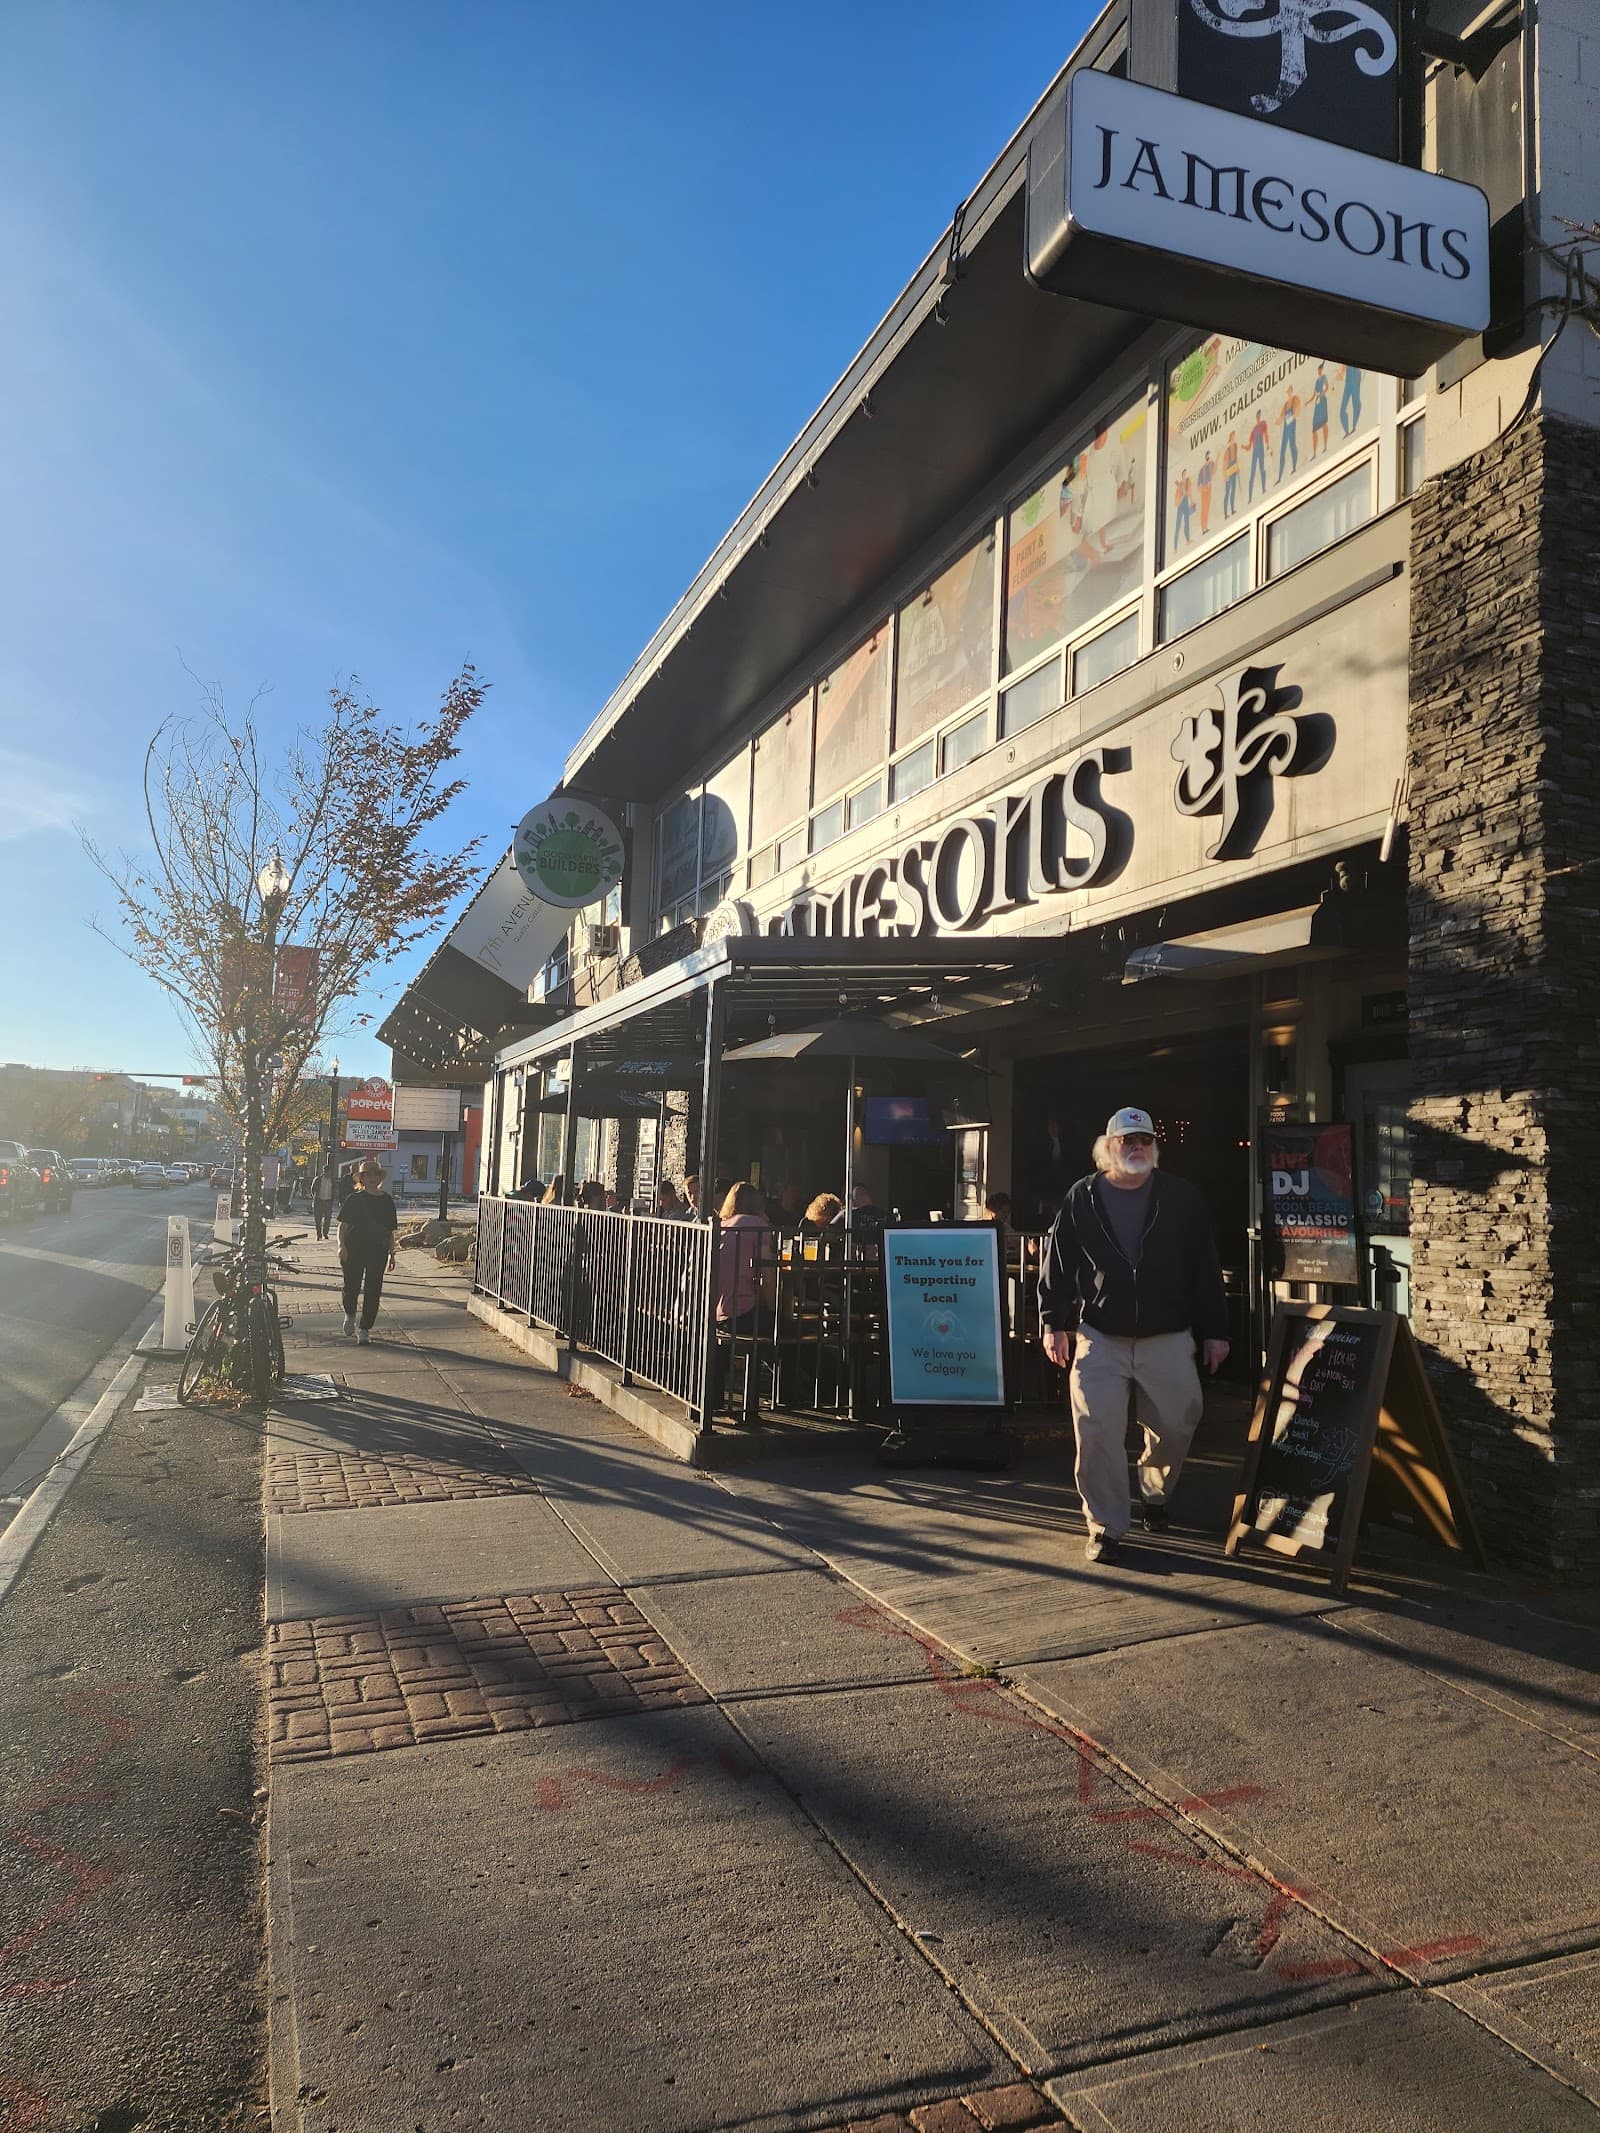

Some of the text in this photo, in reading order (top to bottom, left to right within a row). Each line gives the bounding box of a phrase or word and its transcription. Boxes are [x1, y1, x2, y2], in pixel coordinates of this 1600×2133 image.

[1094, 125, 1470, 280] JAMESONS
[759, 748, 1112, 937] MESONS
[540, 857, 600, 874] BUILDERS
[501, 888, 536, 936] AVENU
[350, 1098, 393, 1111] POPEYE
[1272, 1170, 1310, 1195] DJ
[1273, 1202, 1347, 1213] COOL BEATS
[1274, 1213, 1349, 1227] & CLASSIC
[895, 1256, 984, 1268] Thank you for
[903, 1275, 977, 1287] Supporting
[923, 1293, 959, 1304] Local
[912, 1347, 976, 1362] We love you
[923, 1362, 966, 1376] Calgary
